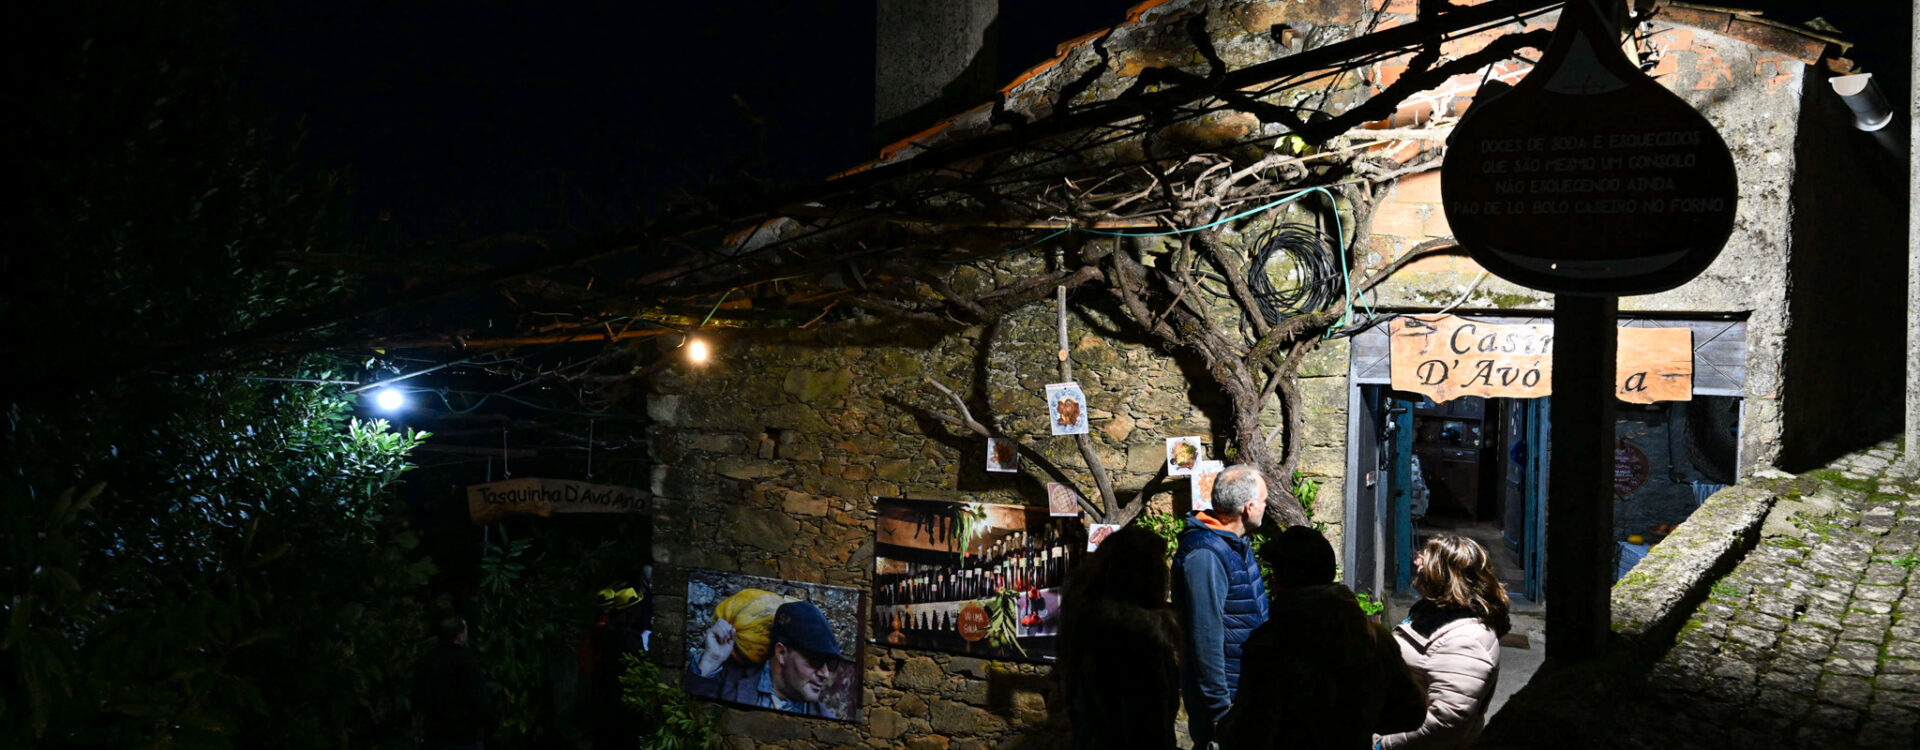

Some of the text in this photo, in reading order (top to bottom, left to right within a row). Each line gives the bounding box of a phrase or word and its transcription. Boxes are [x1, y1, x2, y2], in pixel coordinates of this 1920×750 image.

[1481, 138, 1522, 153] DOCES
[1527, 137, 1545, 151] DE
[1592, 135, 1605, 149] E
[1609, 131, 1701, 148] ESQUECIDOS
[1482, 159, 1508, 174] QUE
[1545, 157, 1595, 172] MESMO
[1601, 156, 1623, 170] UM
[1628, 153, 1696, 169] CONSOLO
[1496, 175, 1676, 193] NÃO ESQUECENDO AINDA
[1484, 200, 1501, 215] DE
[1532, 199, 1569, 215] BOLO
[1643, 198, 1665, 214] NO
[477, 484, 645, 510] Tasquinha D'Avó Ana
